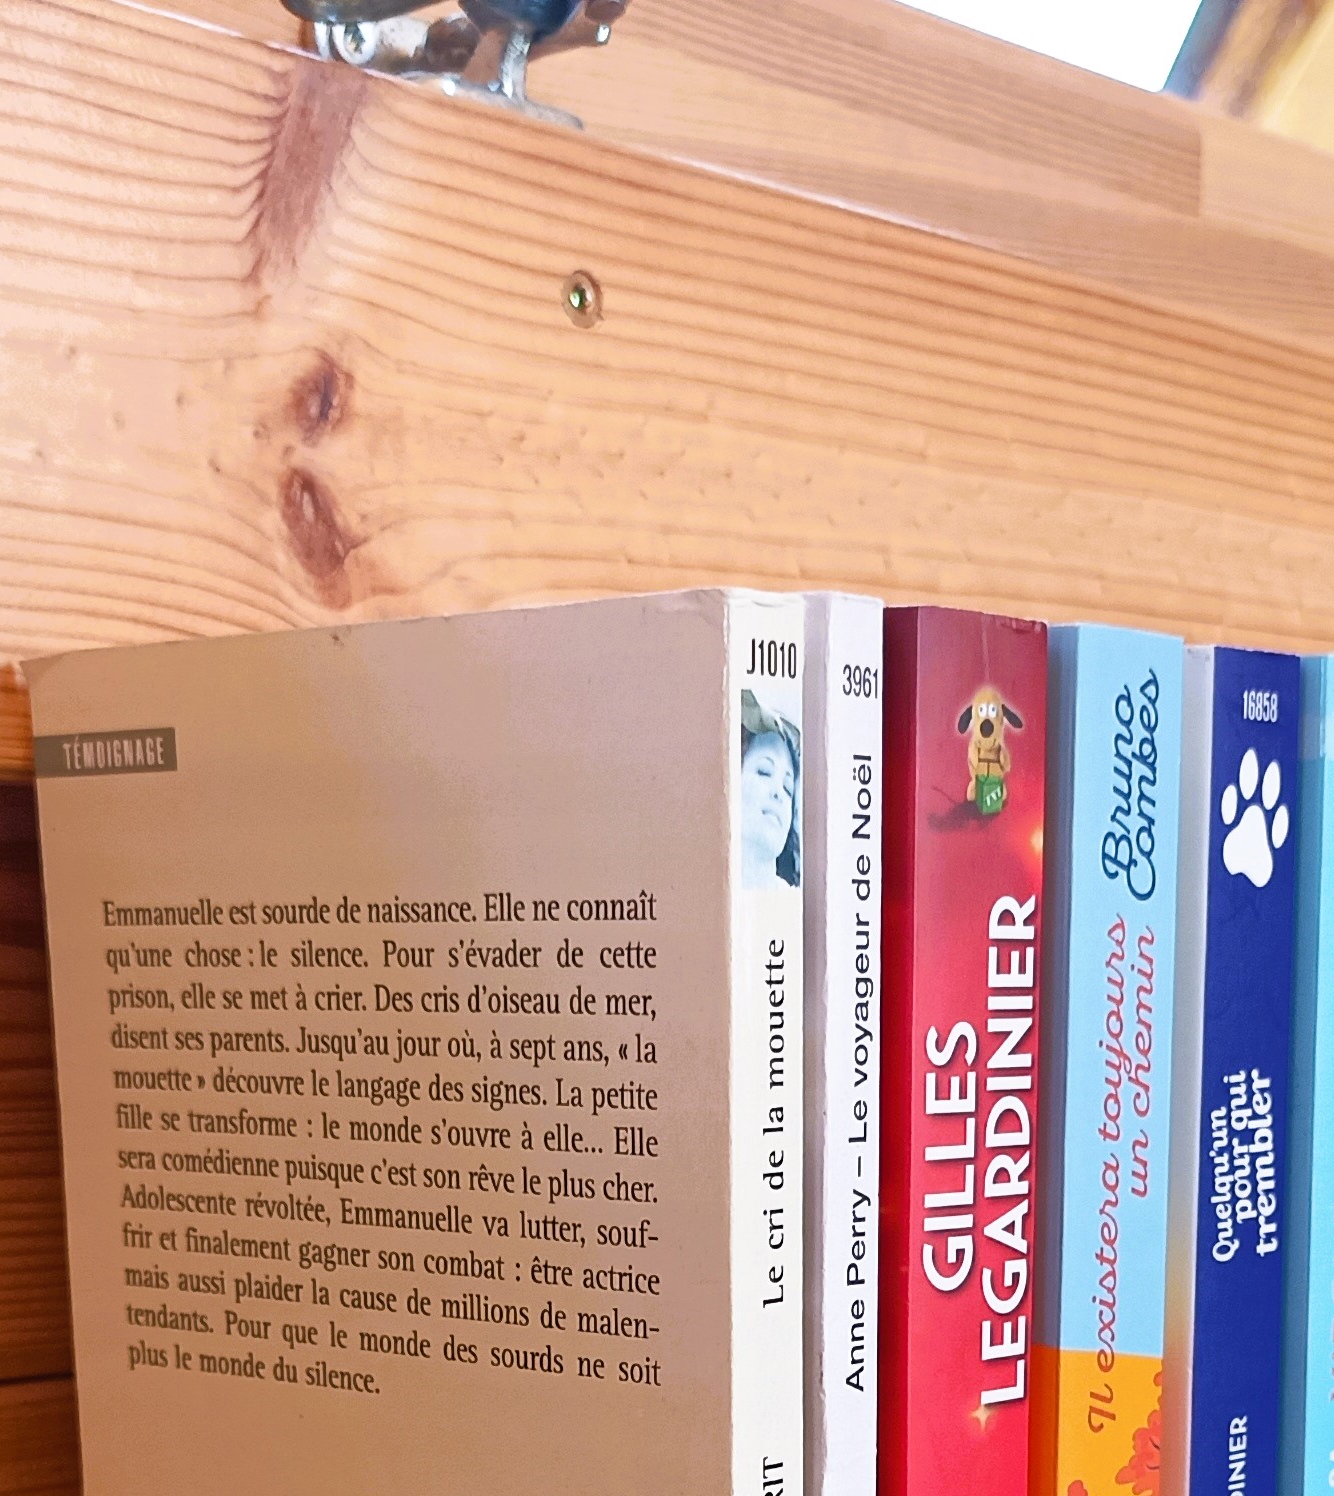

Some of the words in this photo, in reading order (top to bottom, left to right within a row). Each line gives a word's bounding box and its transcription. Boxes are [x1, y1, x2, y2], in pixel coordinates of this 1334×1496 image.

[746, 638, 797, 679] J1010
[842, 664, 878, 699] 3961
[1242, 689, 1278, 723] 16858
[62, 736, 165, 770] TÉMOIGNAGE
[1101, 684, 1134, 879] Bruno
[1127, 668, 1159, 901] Combes
[852, 754, 871, 840] Noël
[102, 897, 223, 926] Emmanuelle
[228, 900, 257, 925] est
[261, 895, 330, 924] sourde
[335, 895, 361, 923] de
[366, 894, 476, 923] naissance.
[483, 891, 525, 922] Elle
[531, 899, 559, 921] ne
[566, 889, 657, 921] connaît
[851, 854, 871, 900] de
[105, 941, 172, 974] qu'une
[184, 939, 241, 967] chose
[258, 939, 277, 967] le
[290, 939, 368, 967] silence.
[381, 939, 434, 967] Pour
[448, 937, 542, 968] s'évader
[556, 937, 583, 968] de
[599, 940, 656, 968] cette
[107, 982, 174, 1015] prison,
[180, 981, 215, 1009] elle
[222, 990, 242, 1009] se
[249, 986, 288, 1010] met
[295, 982, 307, 1010] à
[314, 983, 366, 1011] crier.
[373, 983, 413, 1012] Des
[420, 984, 459, 1013] cris
[467, 983, 561, 1014] d'oiseau
[569, 984, 596, 1015] de
[604, 994, 656, 1021] mer,
[765, 939, 785, 1089] mouette
[854, 912, 874, 1087] voyageur
[1098, 913, 1130, 1142] toujours
[1131, 925, 1154, 1118] chemin
[763, 1106, 784, 1136] la
[849, 1099, 867, 1143] Le
[1223, 1069, 1253, 1131] qui
[763, 1150, 784, 1190] de
[922, 1021, 977, 1291] GILLES
[980, 895, 1036, 1405] LEGARDINIER
[1131, 1129, 1150, 1199] un
[1233, 1137, 1257, 1225] pour
[1247, 1068, 1278, 1257] trembler
[120, 1183, 236, 1215] Adolescente
[244, 1191, 330, 1227] révoltée,
[339, 1197, 472, 1234] Emmanuelle
[481, 1215, 509, 1237] va
[519, 1209, 585, 1248] lutter,
[596, 1218, 658, 1248] souf-
[1209, 1106, 1240, 1263] Quelqu'un
[763, 1208, 784, 1249] cri
[847, 1189, 871, 1285] Perry
[763, 1265, 784, 1308] Le
[1092, 1152, 1118, 1373] existera
[845, 1299, 865, 1392] Anne
[1087, 1382, 1116, 1434] Il
